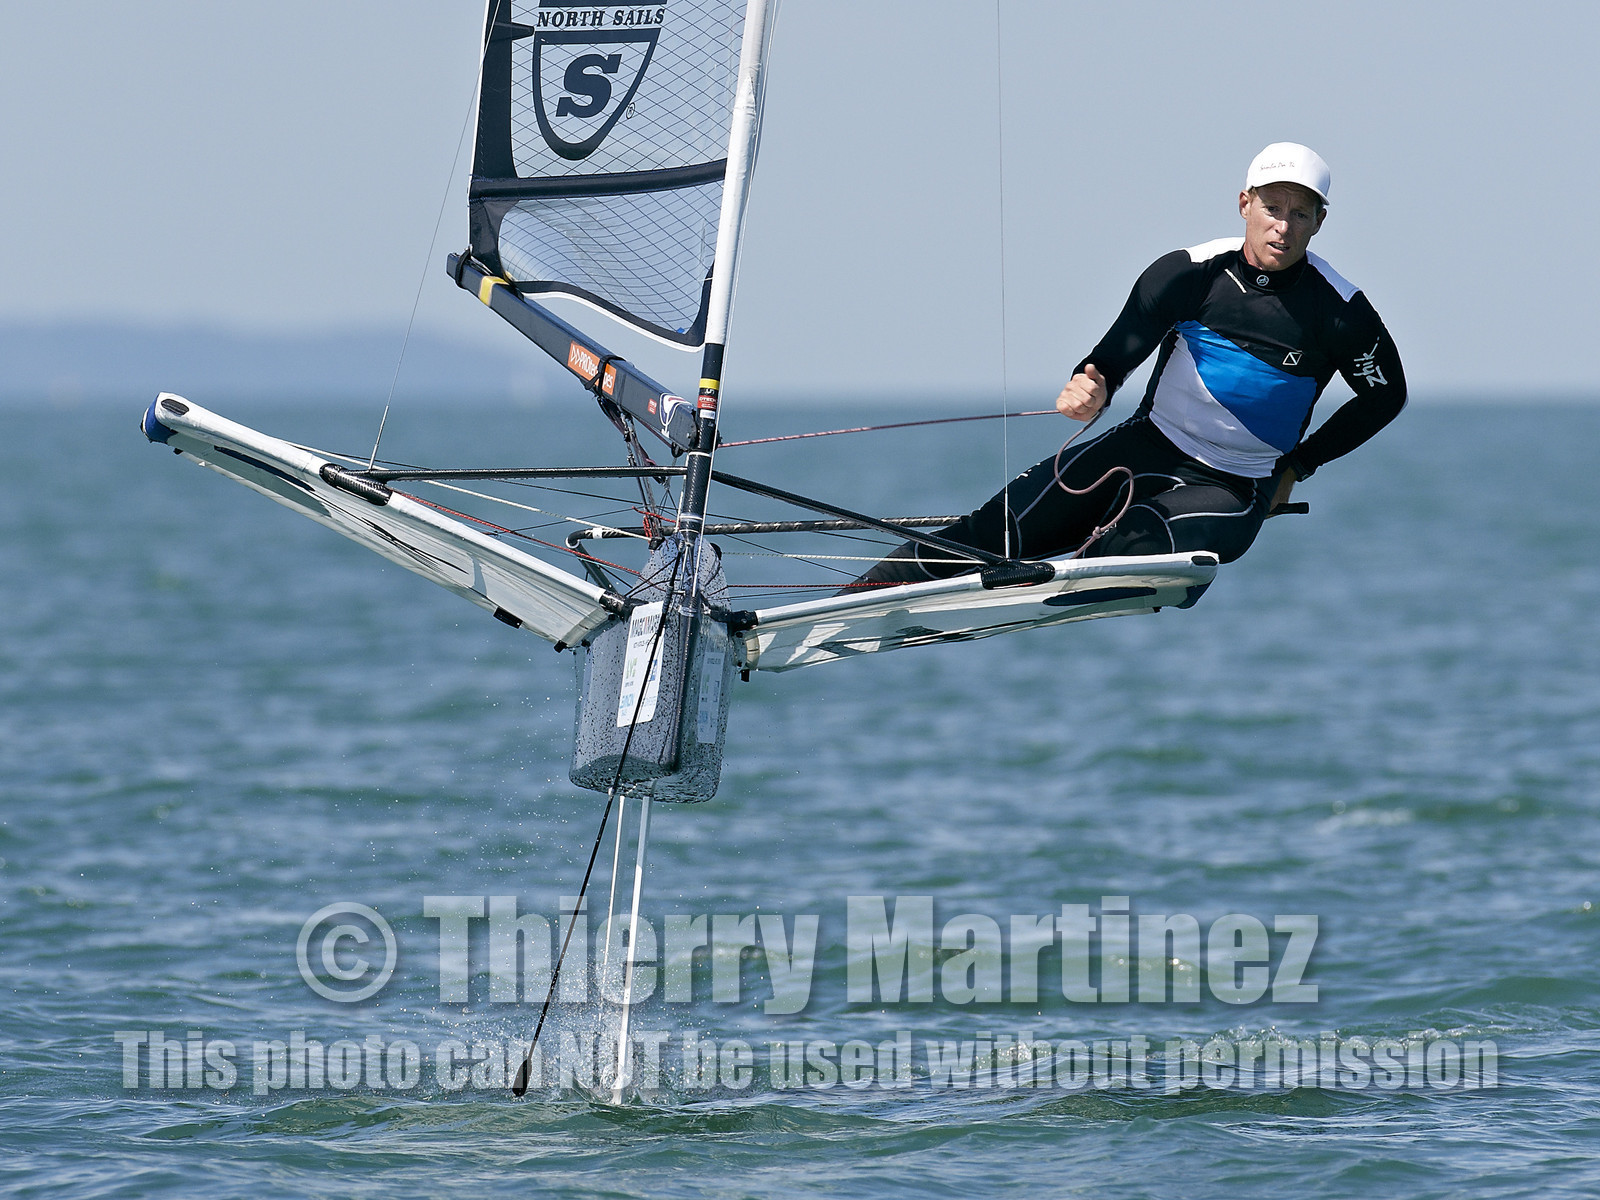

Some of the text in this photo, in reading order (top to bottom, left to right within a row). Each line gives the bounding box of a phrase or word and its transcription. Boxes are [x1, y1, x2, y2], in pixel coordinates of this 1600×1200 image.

[537, 8, 665, 27] NORTH SAILS
[556, 54, 622, 118] S
